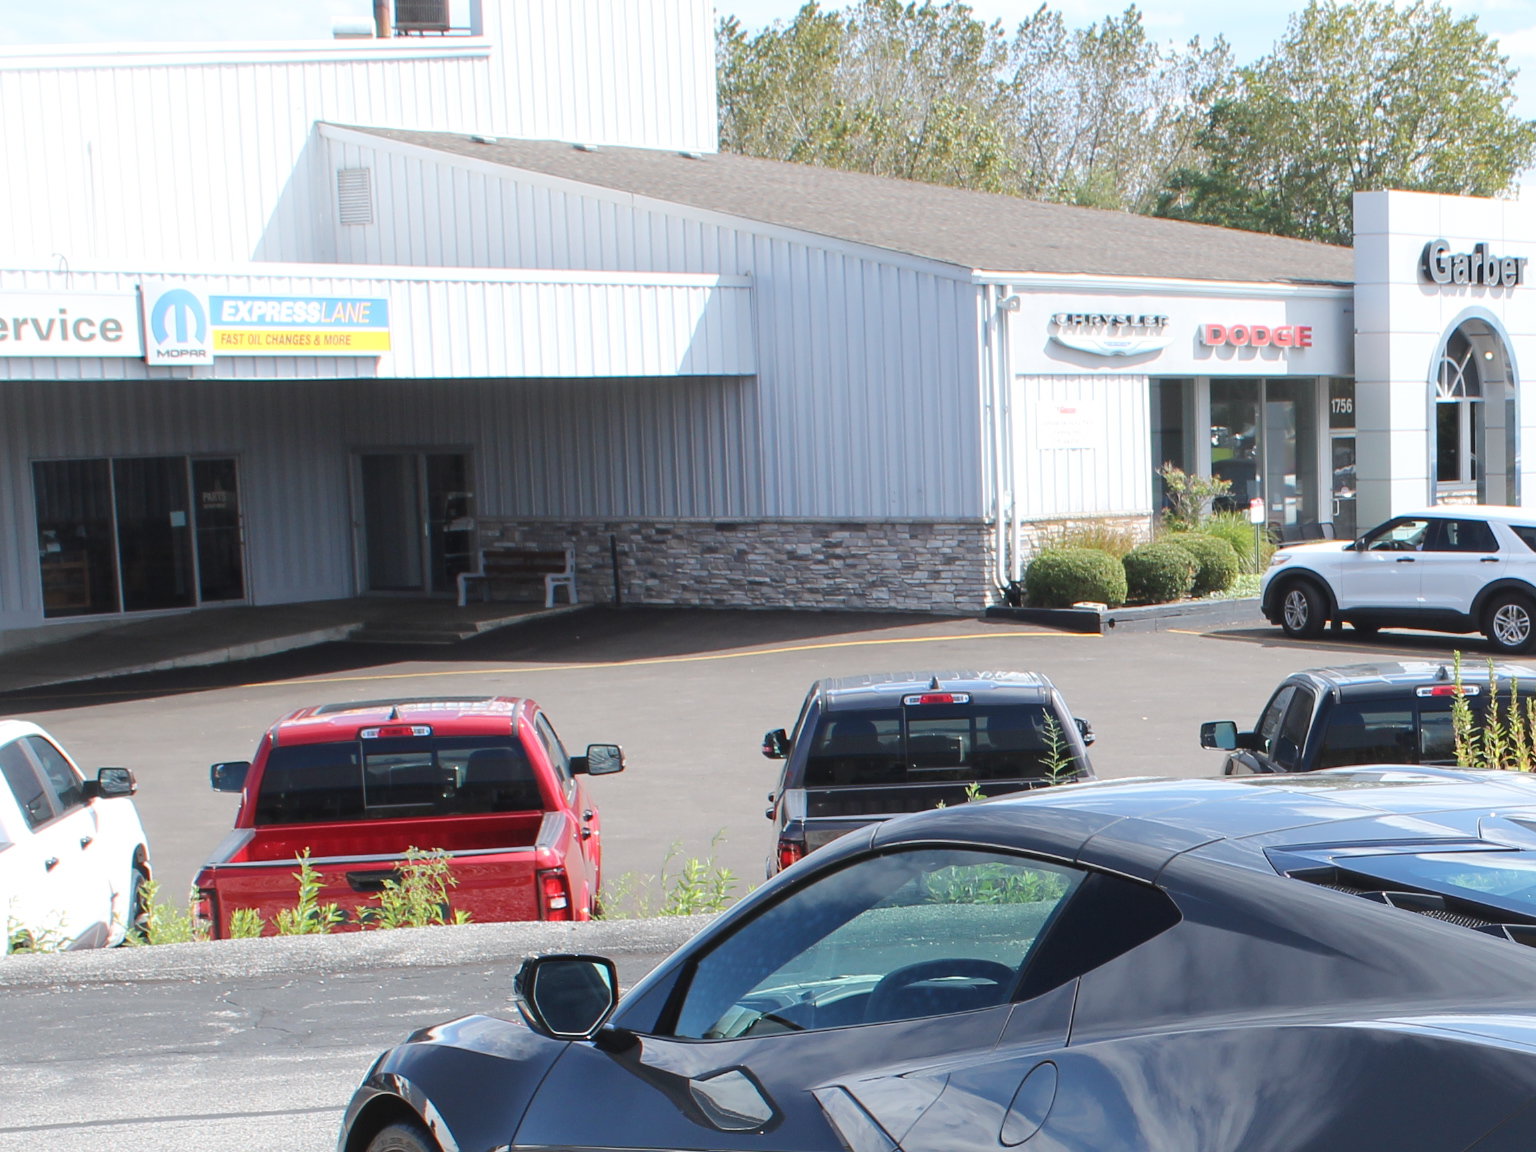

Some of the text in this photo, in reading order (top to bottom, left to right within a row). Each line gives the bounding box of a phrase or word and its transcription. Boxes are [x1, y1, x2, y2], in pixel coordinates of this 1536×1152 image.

[1425, 238, 1528, 287] Garber
[0, 308, 123, 342] rvice
[1053, 312, 1169, 328] CHRYSLER
[221, 333, 351, 346] FAST OIL CHANGES & MORE
[1204, 323, 1313, 348] DODGE
[157, 349, 206, 358] MOPAR
[1331, 397, 1353, 414] 1756
